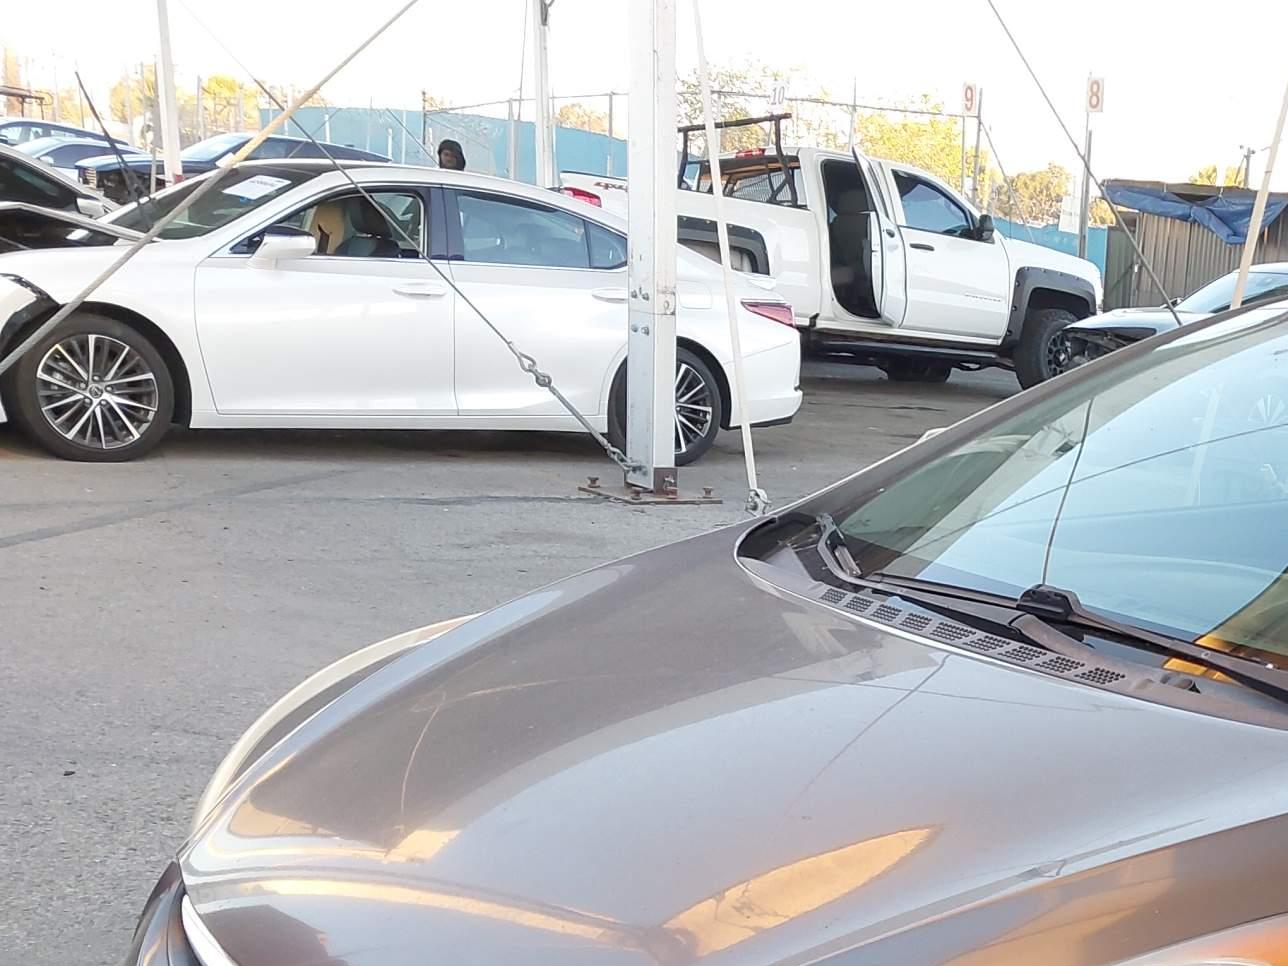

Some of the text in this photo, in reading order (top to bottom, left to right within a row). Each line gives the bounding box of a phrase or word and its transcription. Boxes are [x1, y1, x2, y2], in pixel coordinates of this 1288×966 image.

[771, 86, 785, 105] 10
[964, 86, 974, 112] 9
[1089, 79, 1101, 109] 8
